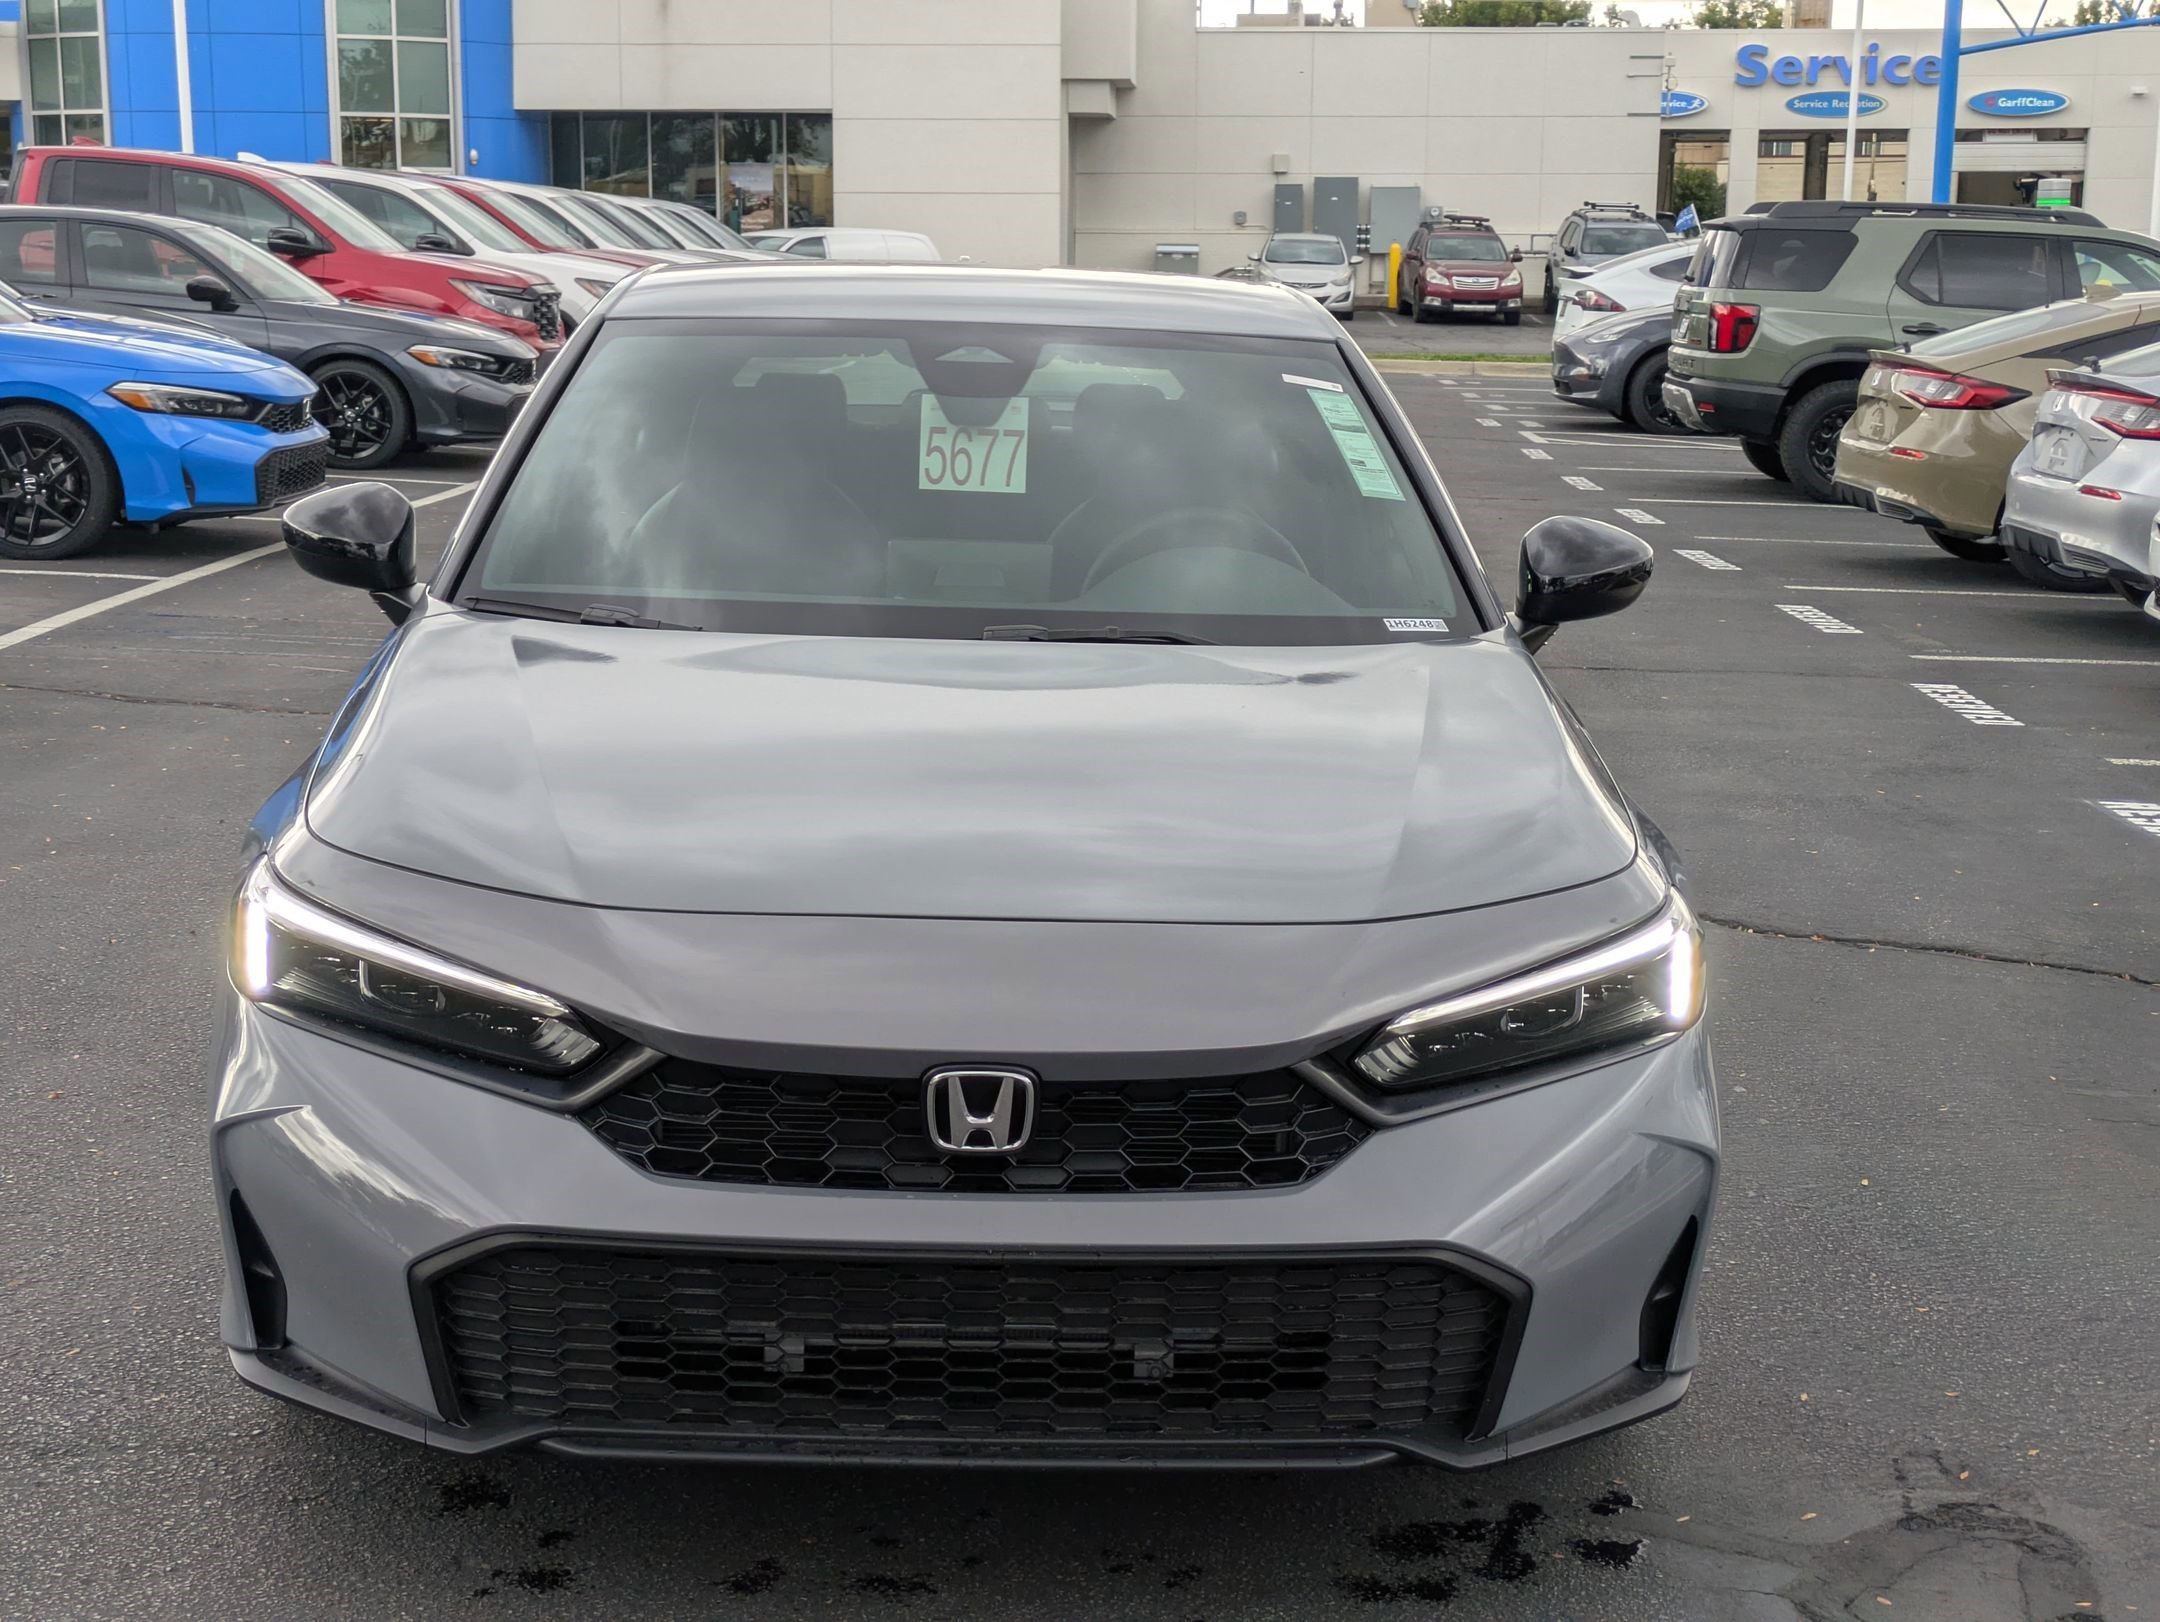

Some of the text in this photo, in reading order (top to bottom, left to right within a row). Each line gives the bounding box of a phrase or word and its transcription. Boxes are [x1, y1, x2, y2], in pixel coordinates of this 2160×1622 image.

[1734, 43, 1943, 87] Service
[1793, 99, 1881, 109] Service Rection
[1998, 97, 2055, 108] GarffClean
[924, 426, 1025, 487] 5677
[1909, 683, 2026, 726] RESERVED
